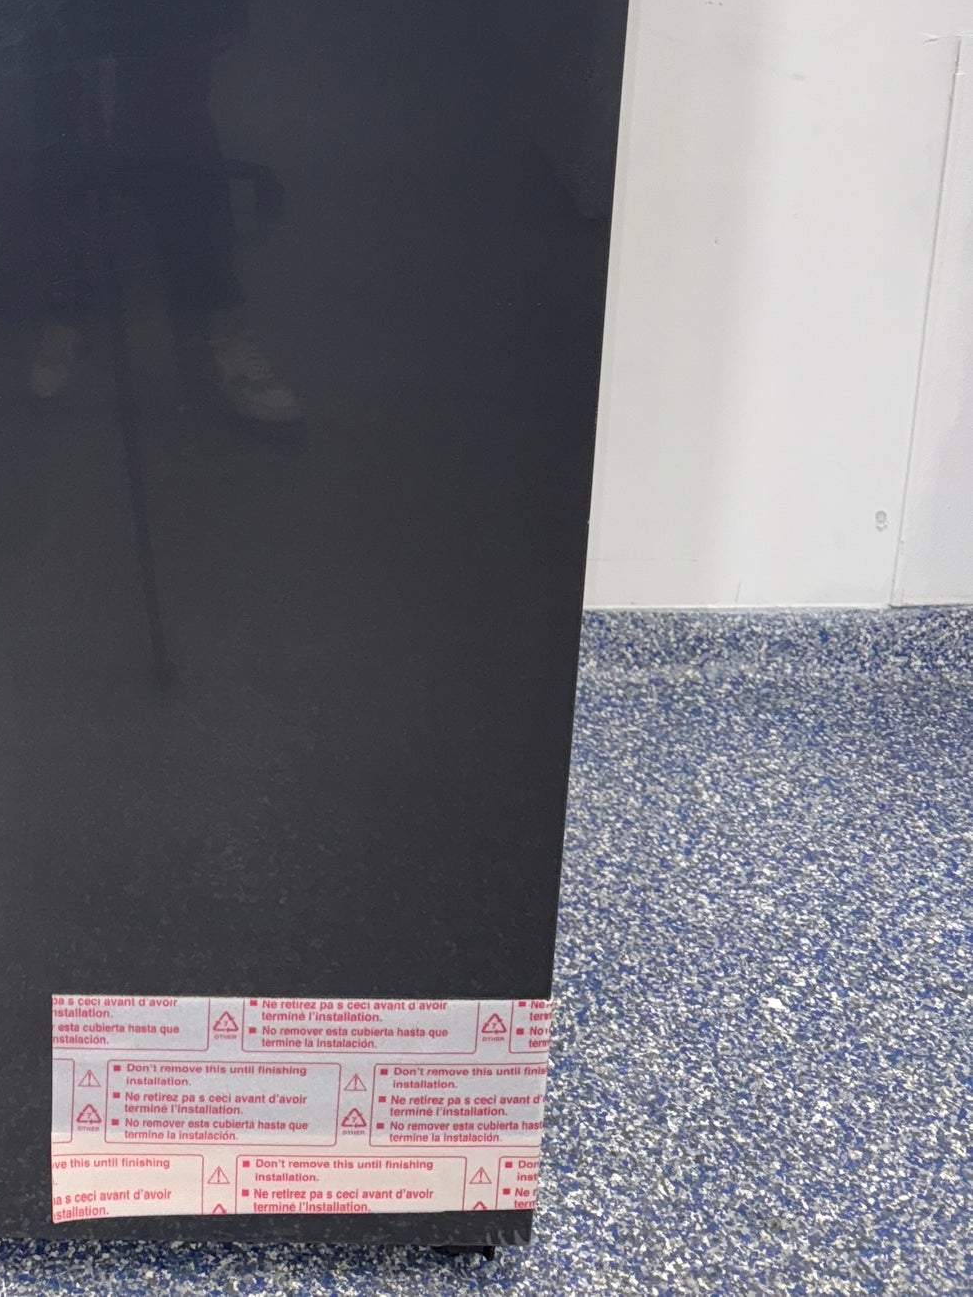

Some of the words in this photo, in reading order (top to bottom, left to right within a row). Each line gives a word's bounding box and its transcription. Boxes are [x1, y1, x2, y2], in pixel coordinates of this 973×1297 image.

[126, 1064, 158, 1072] Don't
[160, 1064, 202, 1074] remove
[204, 1064, 227, 1074] this
[230, 1064, 254, 1073] until
[257, 1064, 308, 1076] finishing
[126, 1076, 192, 1086] installation.
[124, 1091, 140, 1102] Ne
[143, 1092, 178, 1102] retirez
[180, 1094, 195, 1105] pa
[198, 1094, 205, 1102] s
[208, 1095, 231, 1103] ceci
[234, 1095, 266, 1103] avant
[268, 1095, 307, 1104] d'avoir
[124, 1117, 139, 1127] No
[142, 1119, 184, 1129] remover
[187, 1120, 210, 1129] esta
[212, 1119, 255, 1130] cubierta
[256, 1121, 287, 1130] hasta
[287, 1121, 308, 1131] que
[124, 1131, 163, 1139] termine
[167, 1131, 175, 1139] la
[179, 1132, 238, 1141] instalación.
